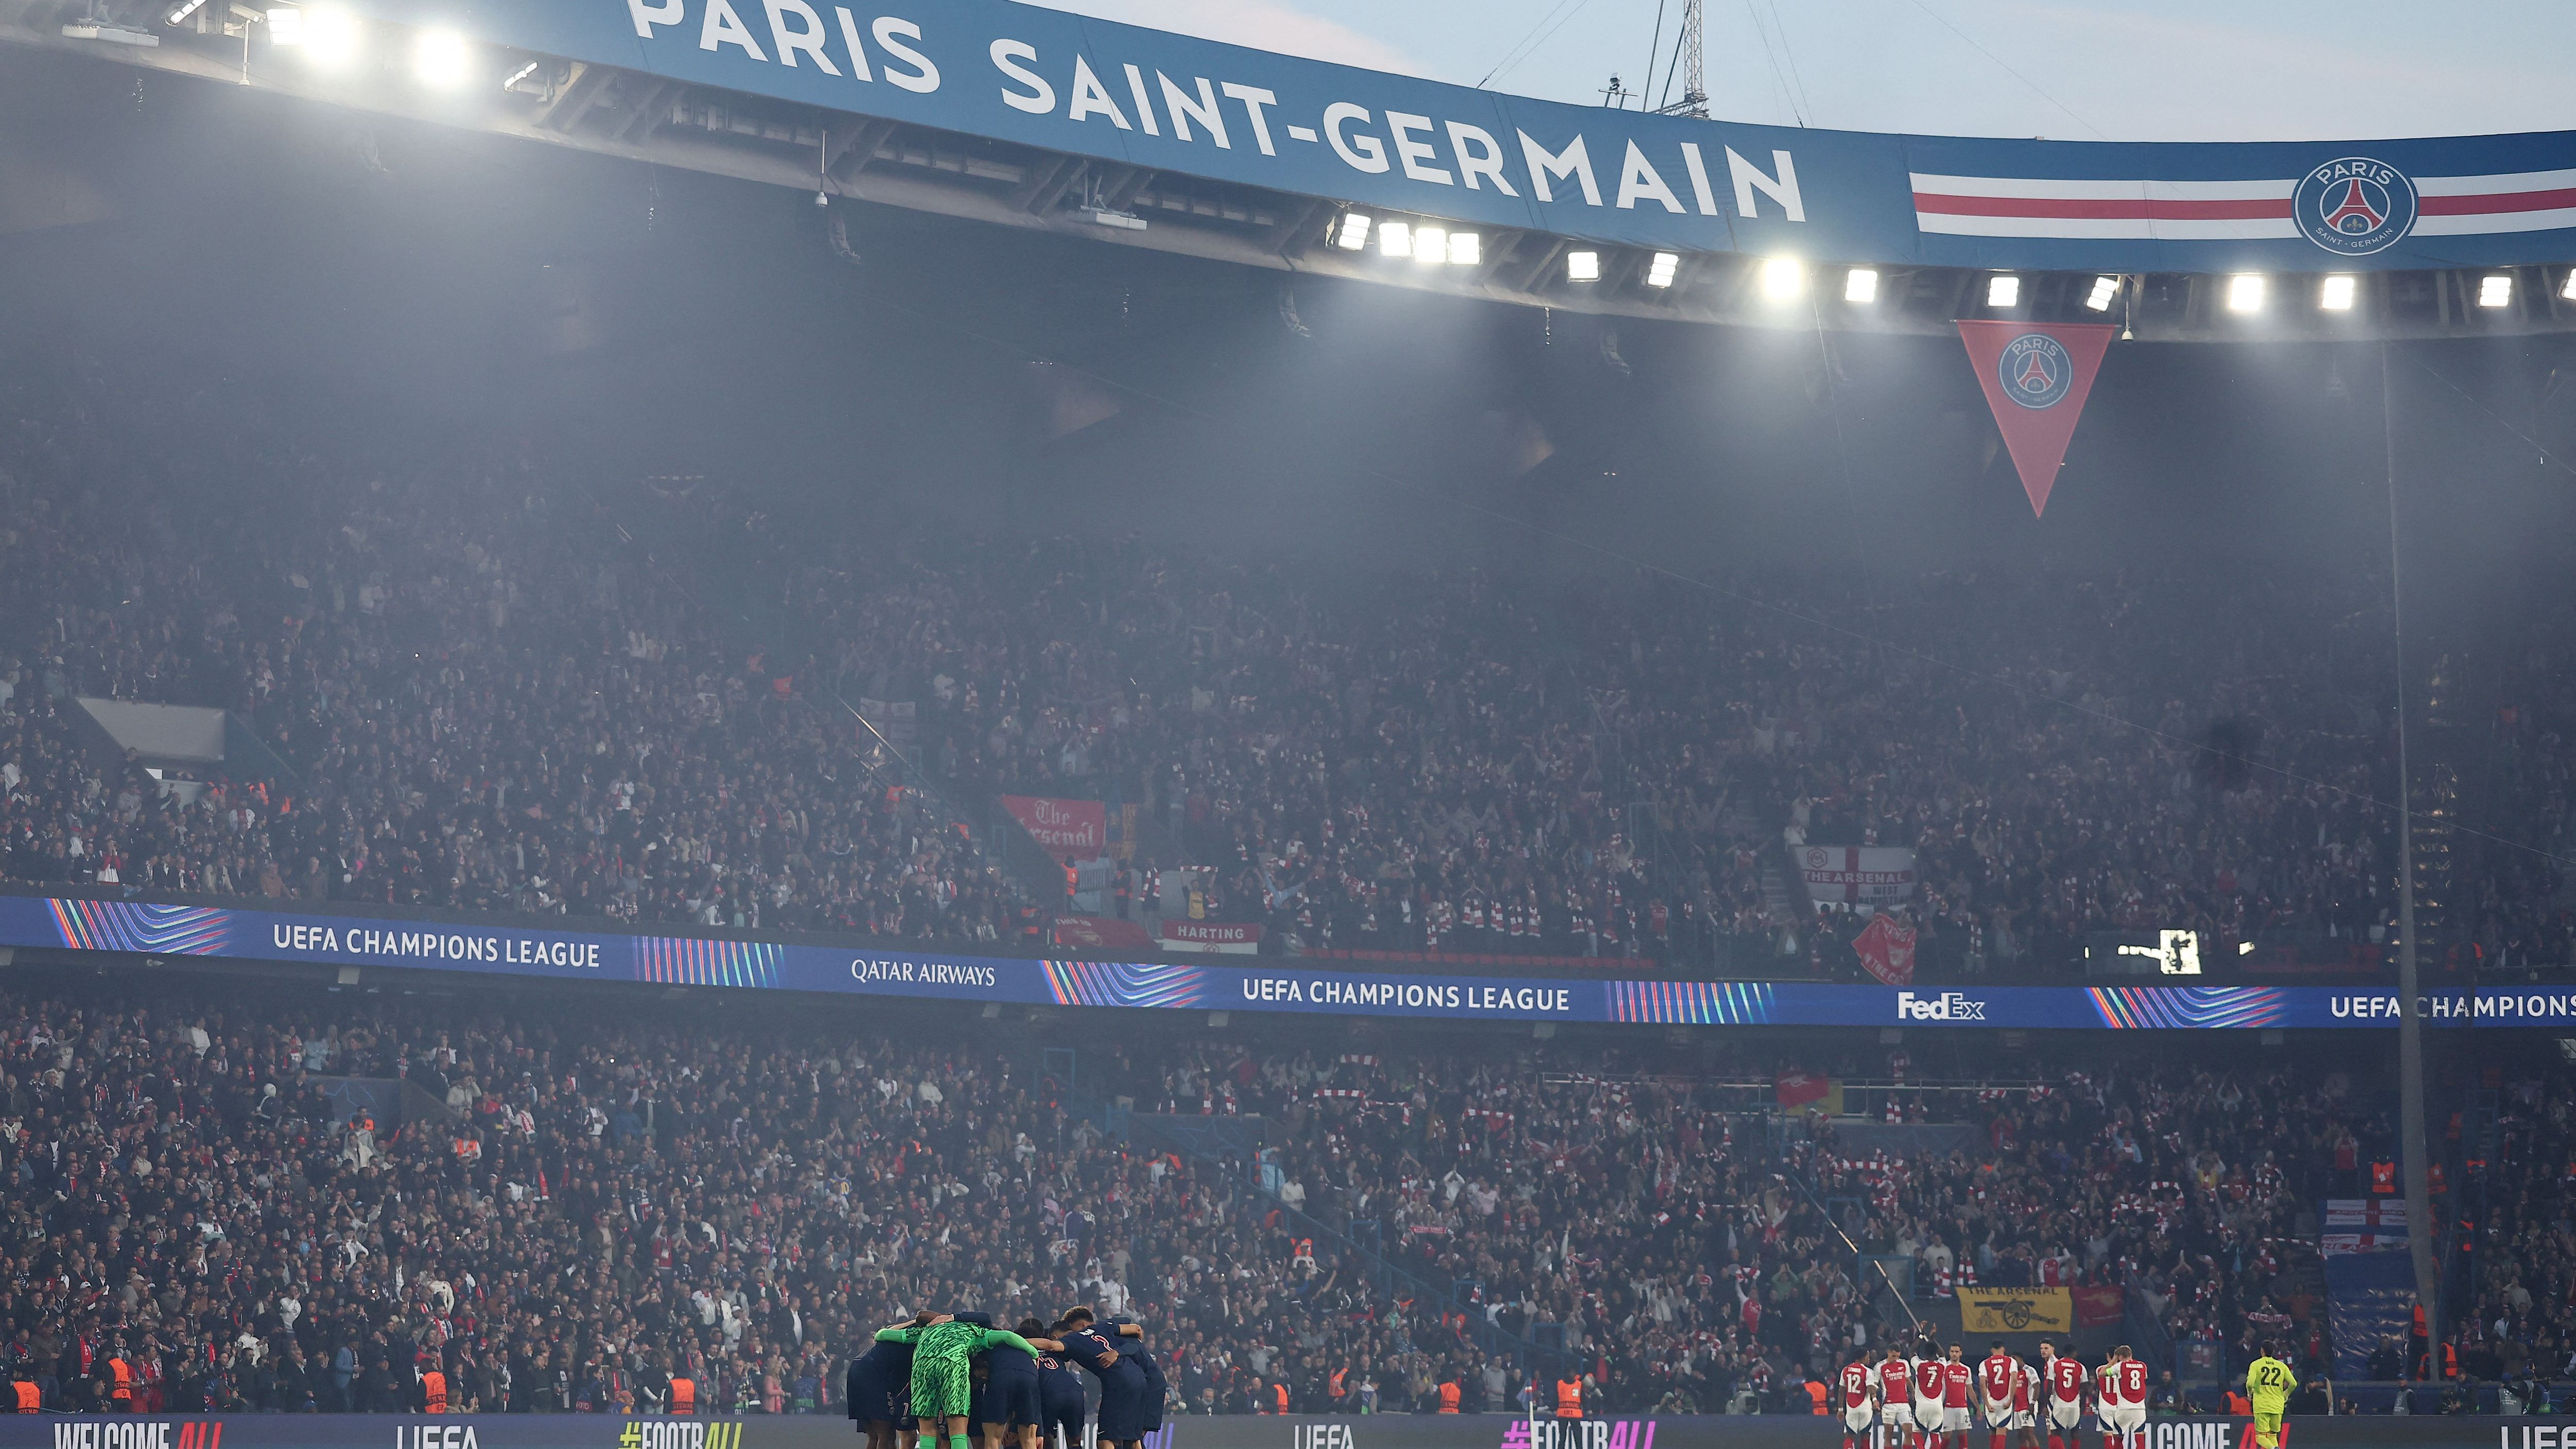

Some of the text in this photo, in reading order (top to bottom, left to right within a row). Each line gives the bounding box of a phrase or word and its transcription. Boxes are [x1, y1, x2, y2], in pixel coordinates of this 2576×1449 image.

[627, 0, 1806, 222] PARIS SAINT-GERMAIN
[2316, 162, 2394, 185] PARIS
[2011, 339, 2058, 356] PARIS
[1035, 800, 1070, 825] The
[1018, 818, 1094, 847] rsenal
[1834, 873, 1905, 884] ARSENAL
[1178, 926, 1244, 939] HARTING
[274, 924, 600, 967] UEFA CHAMPIONS LEAGUE
[851, 959, 995, 987] QATAR AIRWAYS
[1244, 978, 1569, 1010] UEFA CHAMPIONS LEAGUE
[1898, 992, 1986, 1020] FedEx
[2331, 997, 2401, 1018] UEFA
[1997, 1287, 2058, 1296] ARSENAL
[1847, 1373, 1860, 1393] 12
[1927, 1371, 1937, 1388] 7
[1993, 1365, 2004, 1385] 2
[2063, 1369, 2073, 1388] 5
[2130, 1370, 2140, 1390] 8
[2261, 1367, 2281, 1386] 22
[887, 1391, 893, 1406] 5
[903, 1402, 909, 1416] 7
[54, 1422, 170, 1449] WELCOME
[397, 1425, 479, 1449] UEFA
[1294, 1424, 1354, 1449] UEFA
